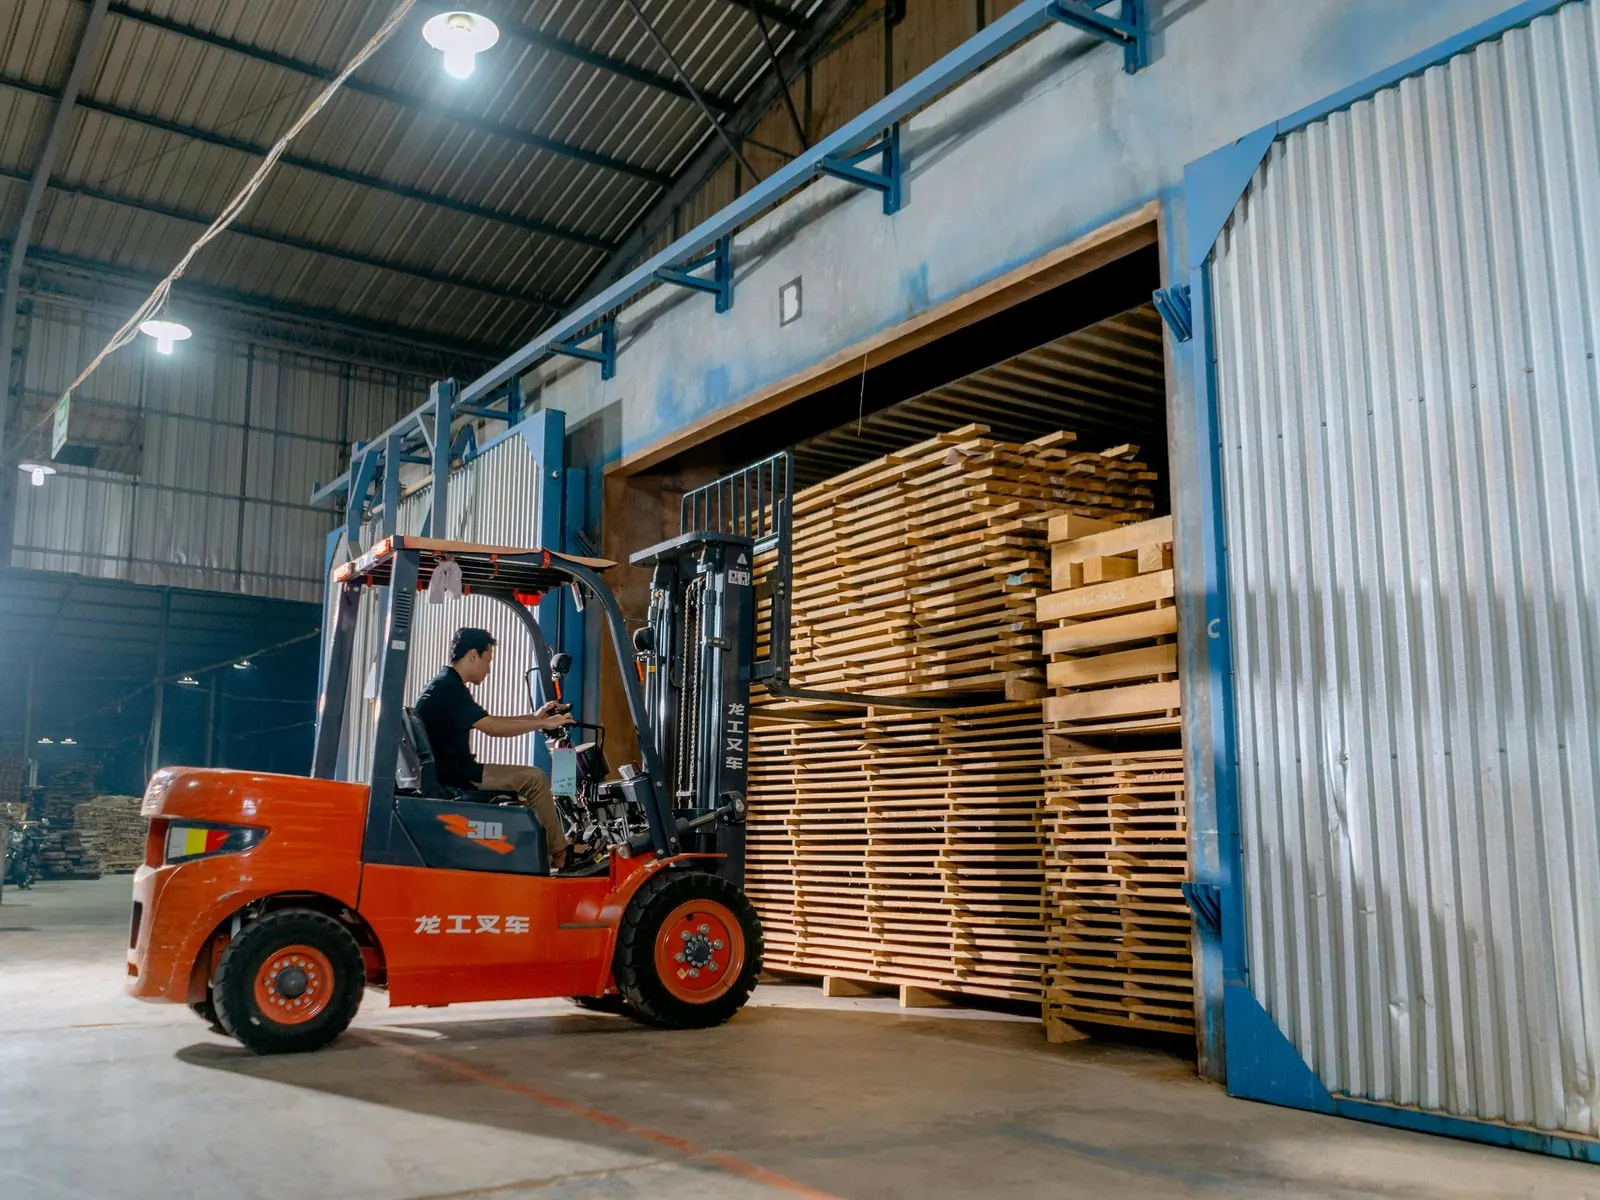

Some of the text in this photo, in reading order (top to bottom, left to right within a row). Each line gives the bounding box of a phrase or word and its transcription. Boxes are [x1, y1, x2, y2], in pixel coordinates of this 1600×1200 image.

[466, 820, 503, 840] 30
[414, 914, 530, 935] 龙工叉车
